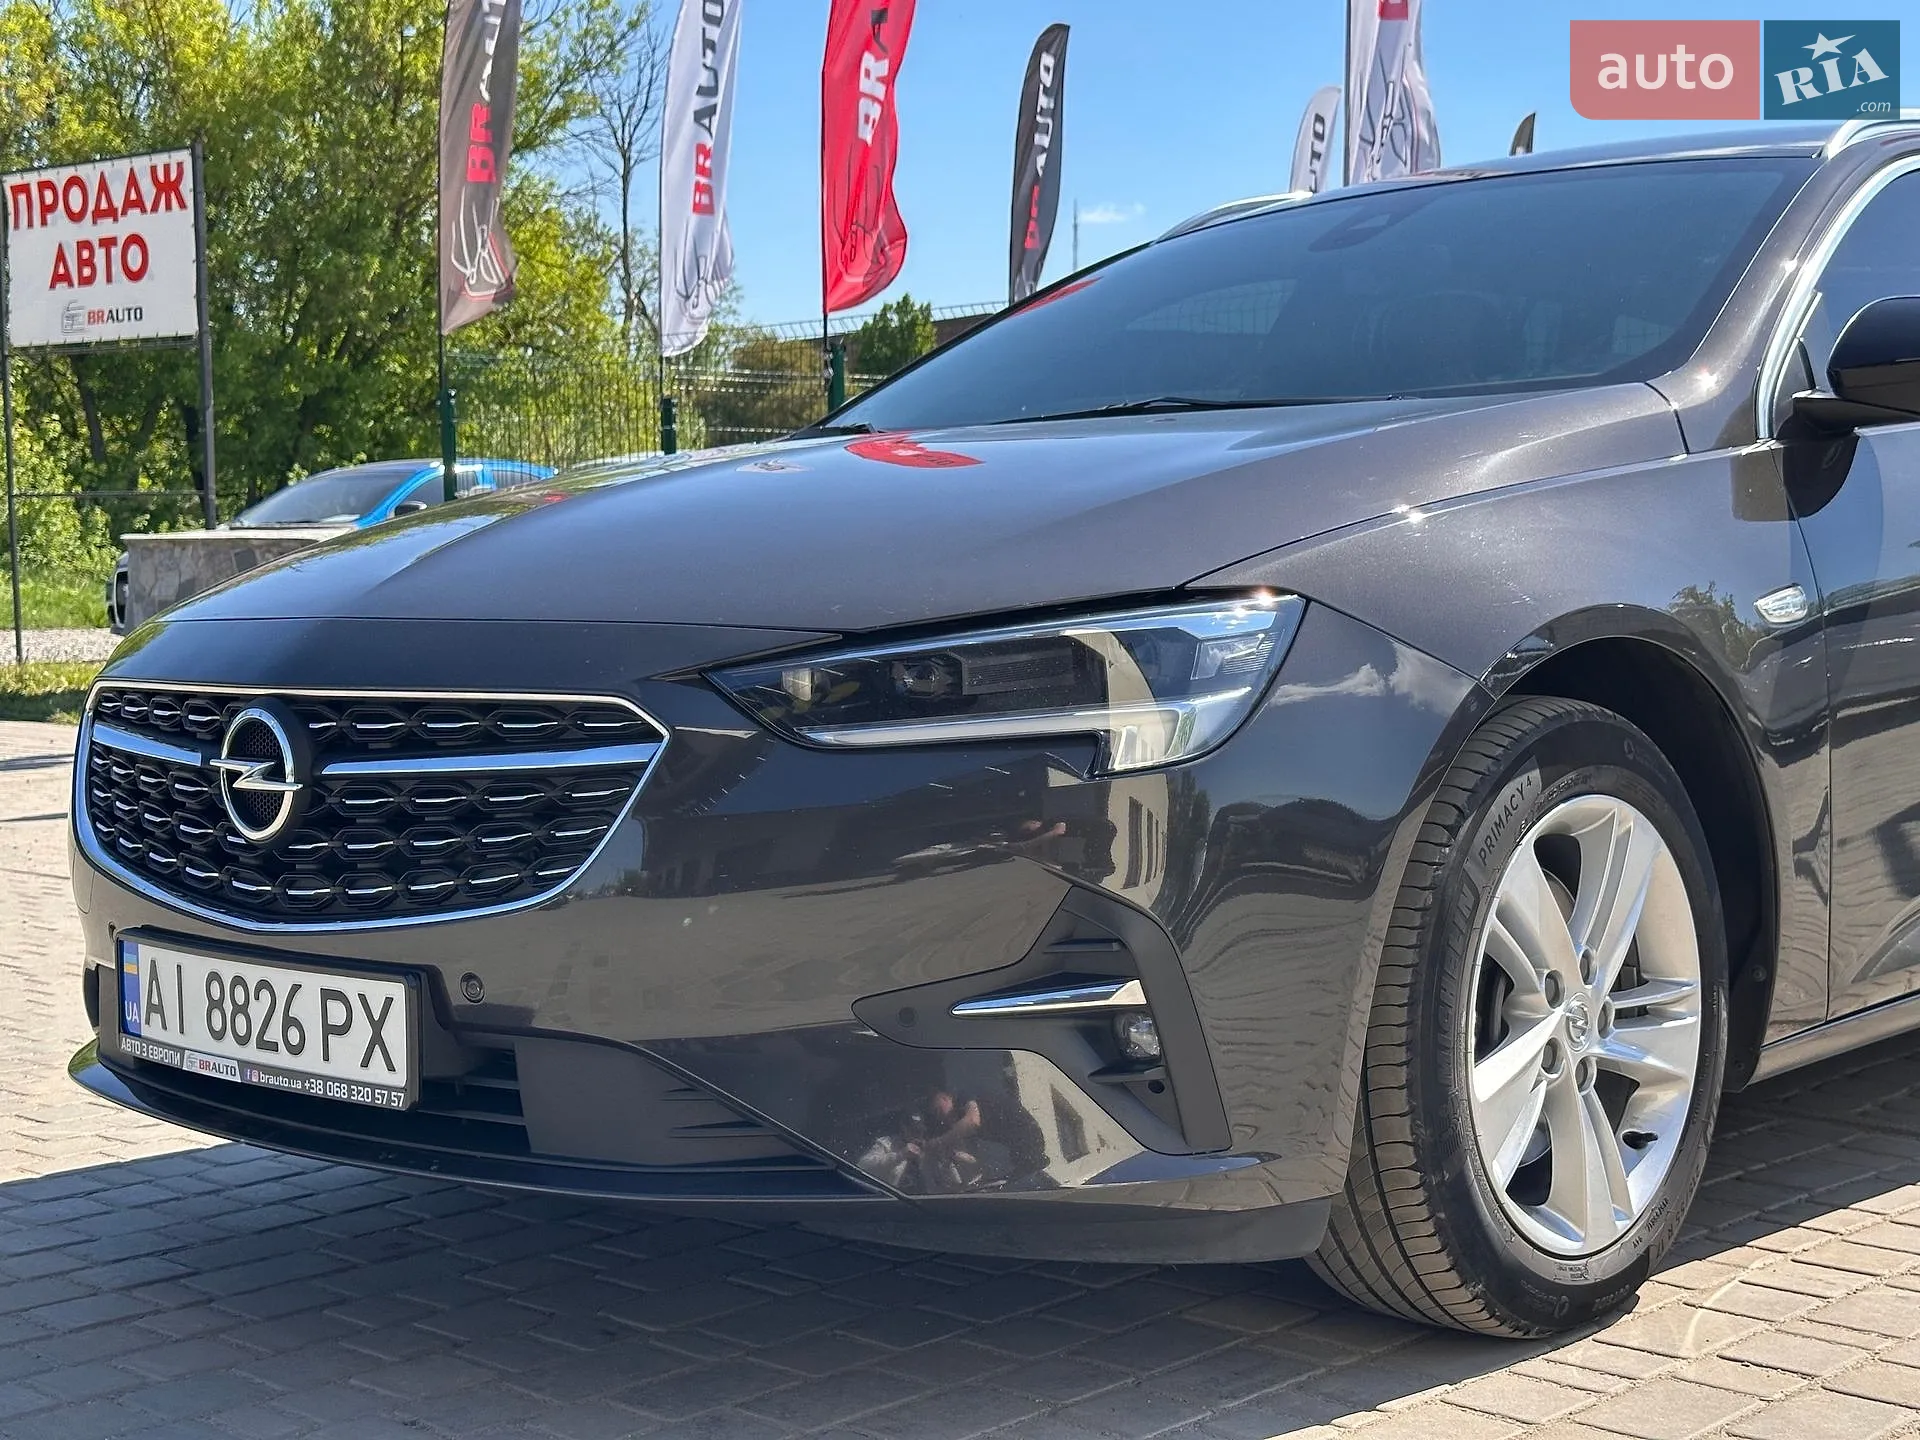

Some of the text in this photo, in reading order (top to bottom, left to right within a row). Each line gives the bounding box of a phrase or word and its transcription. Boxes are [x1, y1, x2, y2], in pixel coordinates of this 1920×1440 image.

[9, 161, 188, 231] ПРОДАЖ
[49, 233, 149, 291] АВТО
[87, 307, 143, 325] BRAUTO
[1479, 775, 1532, 867] PRIMACY 4
[124, 1000, 140, 1024] UA
[144, 958, 397, 1073] AI 8826 PX
[121, 1037, 141, 1055] АВТО
[199, 1059, 237, 1077] BRAUTO
[259, 1071, 404, 1108] brauto.ua +38 068 320 57 57
